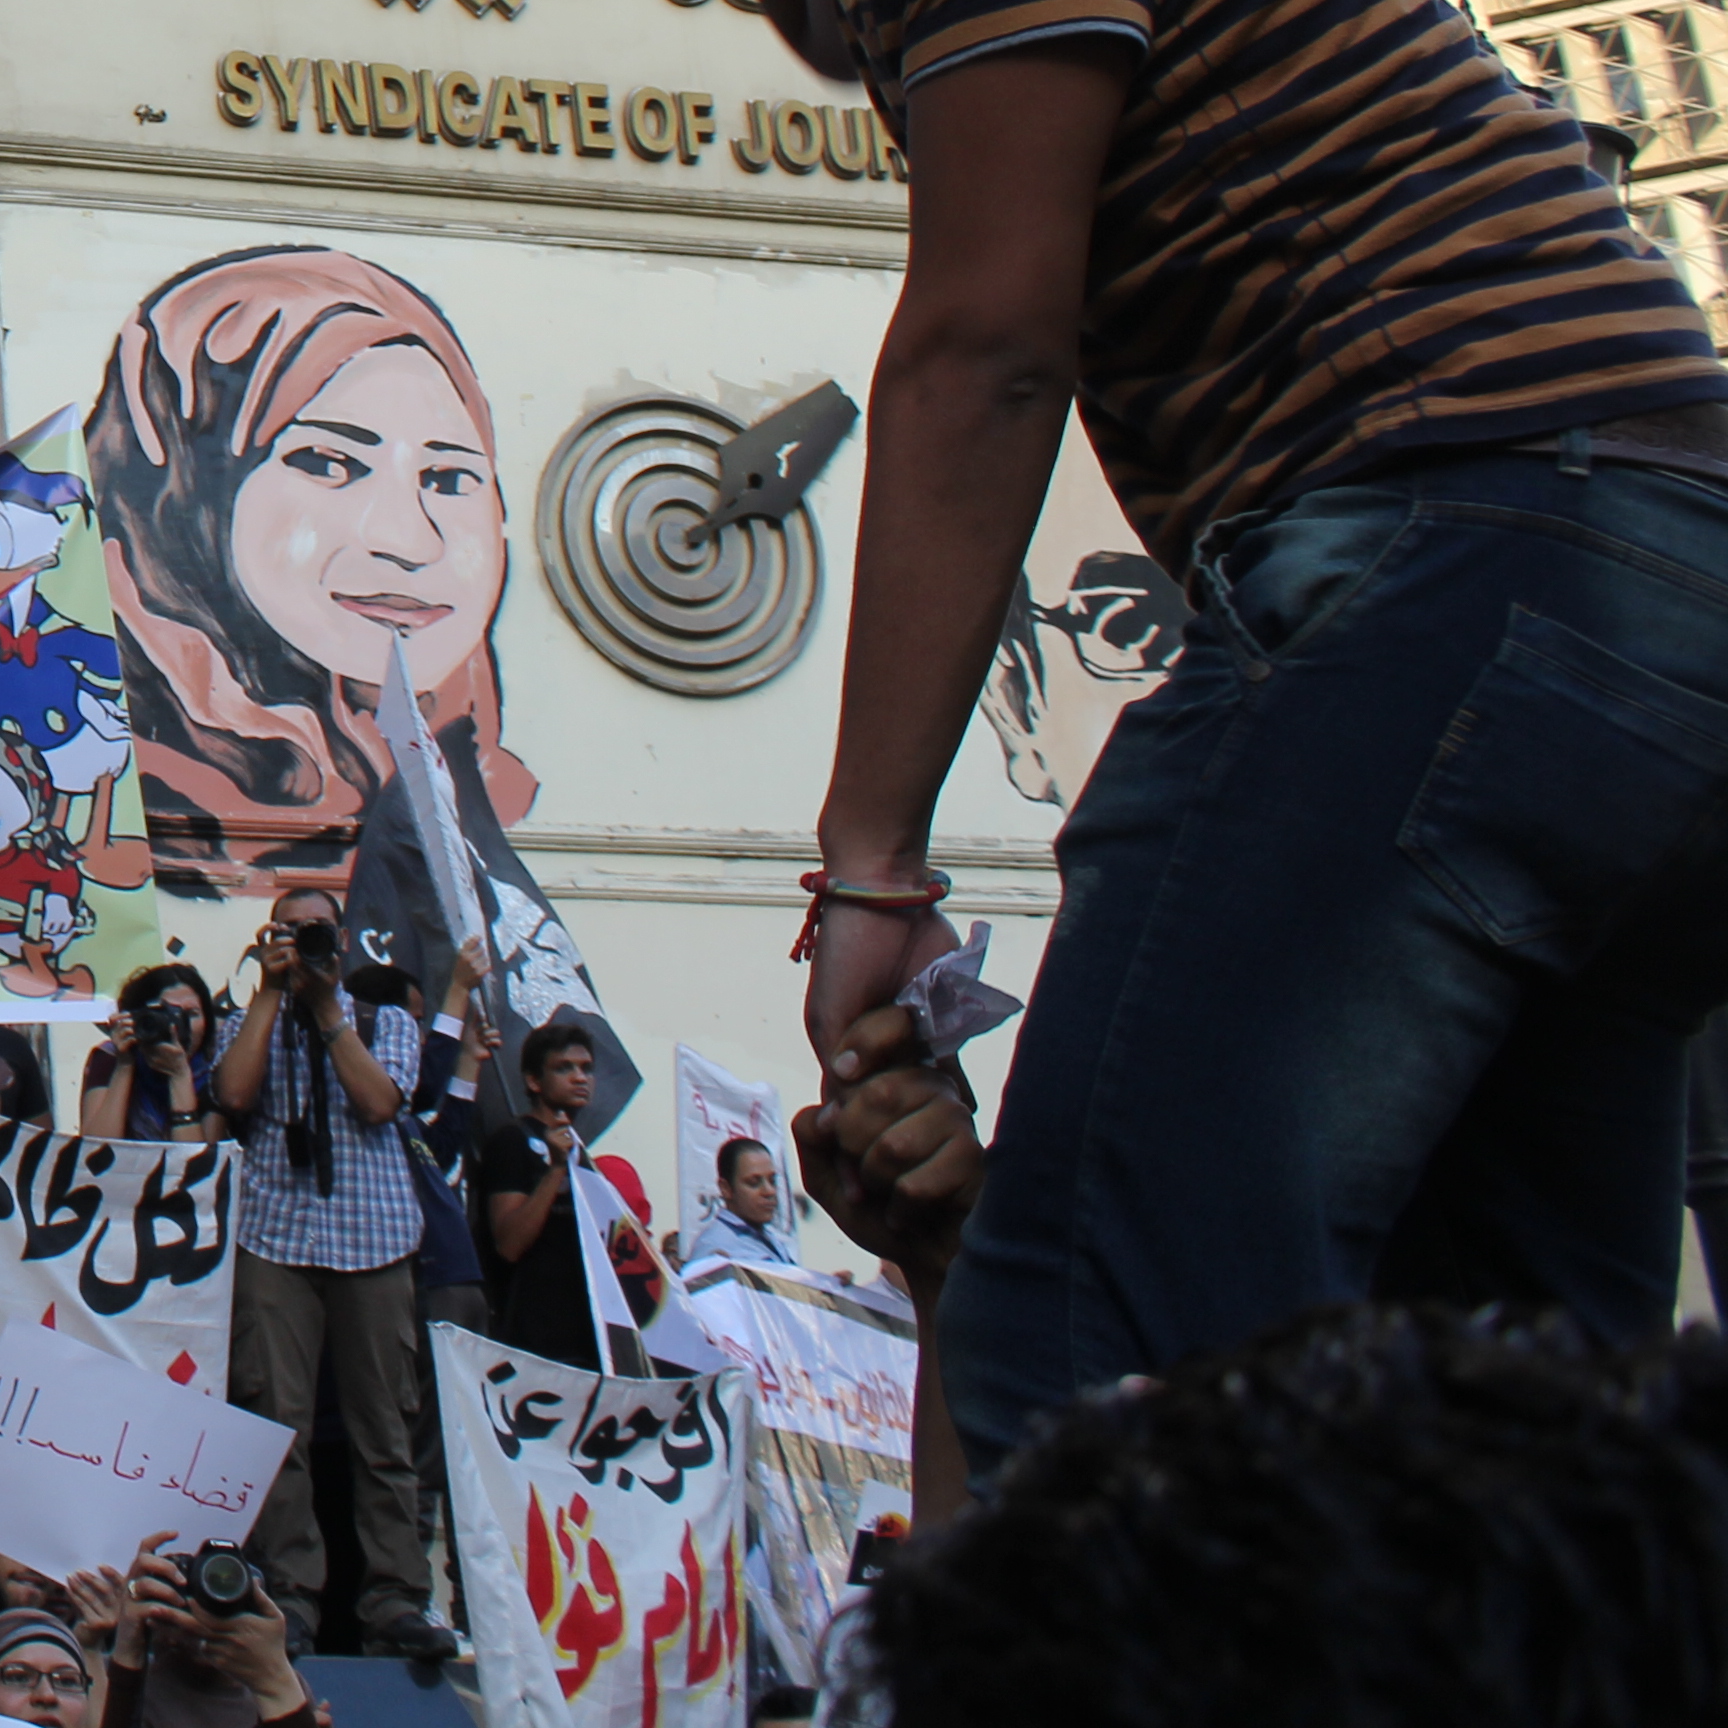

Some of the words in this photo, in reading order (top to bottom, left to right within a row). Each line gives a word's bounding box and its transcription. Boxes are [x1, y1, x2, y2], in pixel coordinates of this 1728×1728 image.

[214, 48, 617, 160] SYNDICATE
[623, 82, 718, 166] OF
[480, 1360, 564, 1460] عن
[159, 1428, 255, 1513] قضاء
